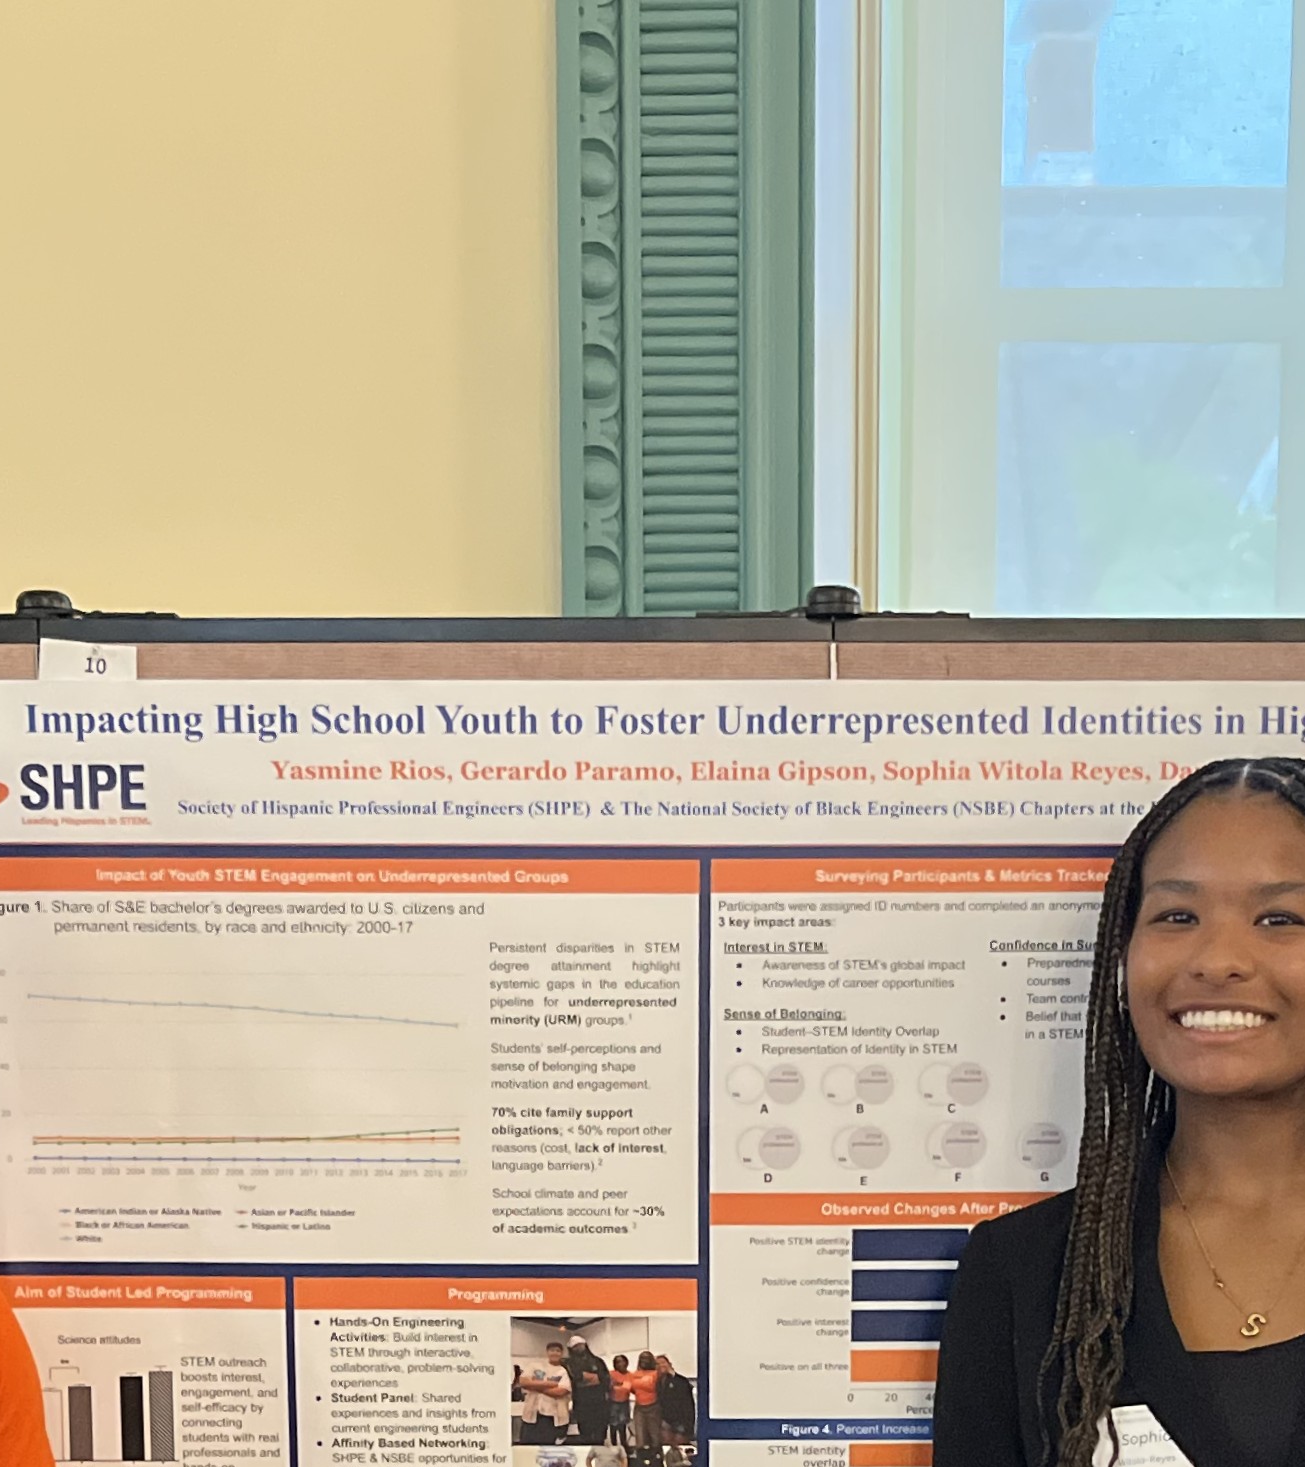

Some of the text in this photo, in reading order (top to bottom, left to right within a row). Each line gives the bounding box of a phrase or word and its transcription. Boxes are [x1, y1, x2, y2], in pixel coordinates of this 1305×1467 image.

[83, 656, 108, 676] 10
[25, 703, 204, 743] Impacting
[215, 703, 298, 744] High
[311, 704, 426, 735] School
[435, 704, 538, 735] Youth
[550, 708, 583, 735] to
[596, 705, 706, 736] Foster
[718, 705, 1029, 744] Underrepresented
[1044, 705, 1202, 735] Identities
[1214, 705, 1245, 735] in
[270, 759, 1152, 787] Yasmine Rios, Gerardo Paramo, Elaina Gipson, Sophia Witola Reyes,
[19, 763, 147, 811] SHPE
[177, 799, 1144, 821] Society of Hispanic Professional Engineers (SHPE) & The National Society of Black Engineers (NSBE) Chapters at the
[95, 868, 570, 886] Impact of Youth STEM Engagement on Underrepresented Groups
[815, 868, 1050, 886] Surveying Participants & Metrics
[51, 899, 93, 915] Share
[95, 899, 112, 915] of
[114, 899, 147, 915] S&E
[149, 900, 224, 917] bachelor's
[225, 901, 284, 919] degrees
[286, 901, 347, 917] awarded
[350, 902, 365, 916] to
[402, 902, 455, 917] citizens
[458, 902, 486, 917] and
[53, 919, 131, 936] permanent
[204, 920, 222, 936] by
[226, 921, 258, 935] race
[260, 920, 287, 934] and
[356, 920, 414, 935] 2000-17
[488, 941, 681, 955] Persistent disparities in STEM
[723, 941, 771, 955] Interest
[772, 941, 786, 955] in
[722, 1008, 762, 1022] Sense
[764, 1008, 777, 1022] of
[491, 1106, 634, 1121] 70% cite family support
[820, 1201, 996, 1218] Observed Changes After
[447, 1287, 545, 1304] Programming
[329, 1316, 465, 1330] Hands-On Engineering
[781, 1422, 820, 1437] Figure
[836, 1423, 880, 1436] Percent
[882, 1423, 931, 1437] Increase
